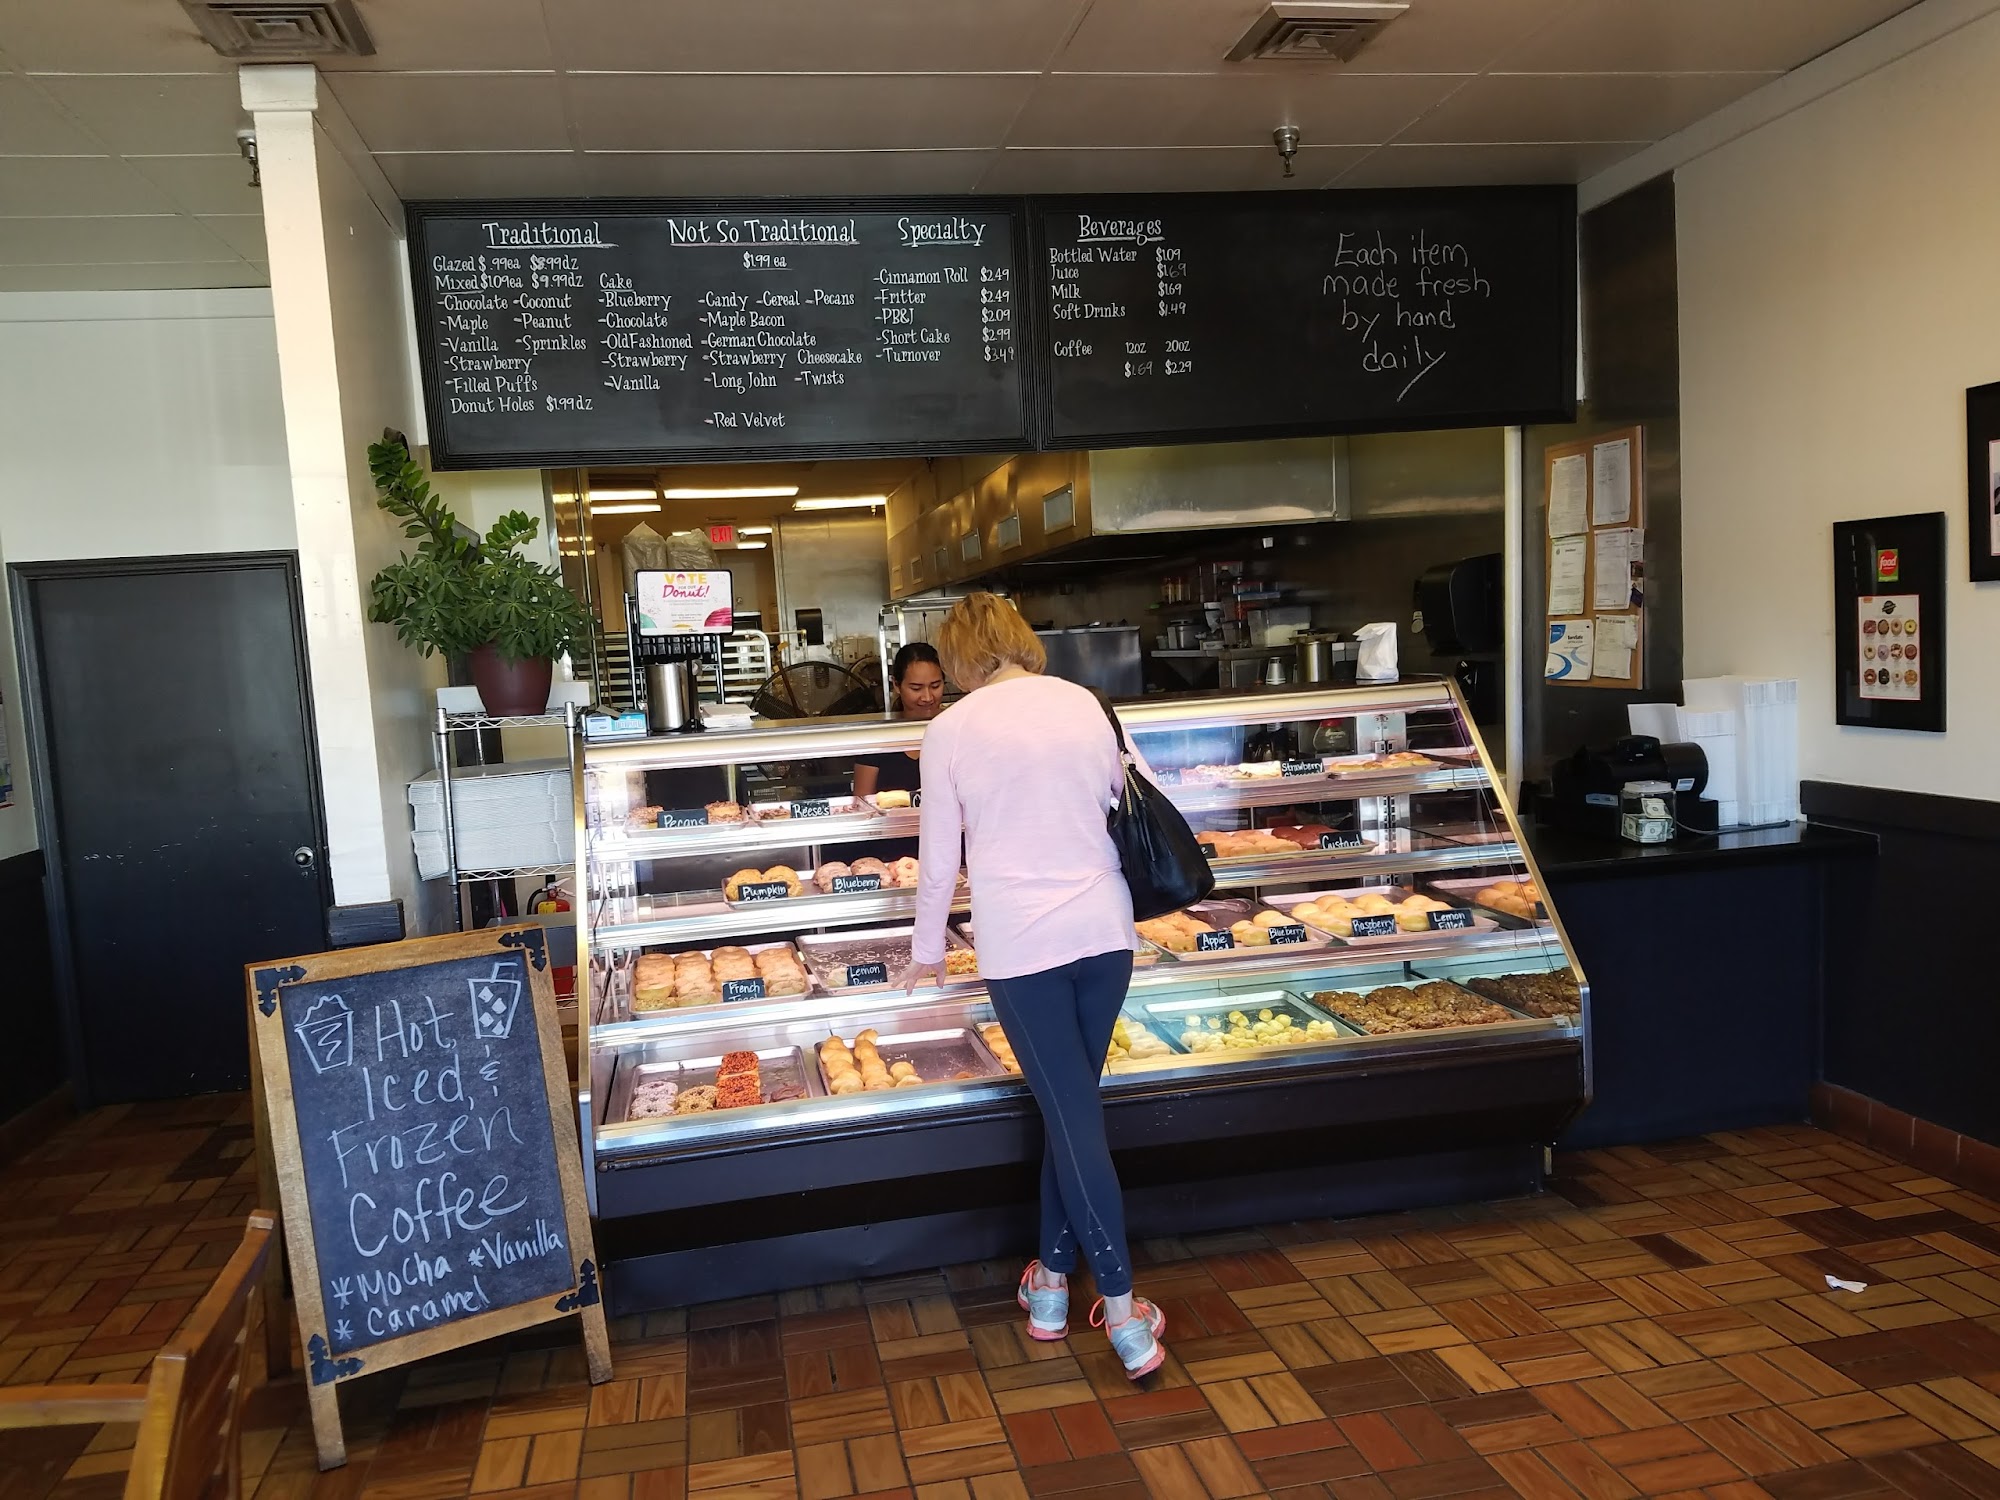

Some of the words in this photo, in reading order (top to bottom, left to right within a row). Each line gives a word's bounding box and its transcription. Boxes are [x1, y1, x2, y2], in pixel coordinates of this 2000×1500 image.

[482, 222, 602, 245] Traditional
[667, 219, 710, 244] Not
[716, 220, 739, 243] So
[744, 219, 857, 243] Traditional
[898, 217, 986, 247] Specialty
[1078, 214, 1162, 246] Beverages
[1050, 247, 1094, 264] Bottled
[1096, 247, 1137, 263] Water
[1335, 230, 1397, 267] Each
[1411, 229, 1468, 267] item
[433, 256, 476, 272] Glazed
[1051, 264, 1080, 280] Juice
[435, 275, 480, 290] Mixed
[600, 273, 633, 289] Cake
[944, 266, 968, 283] Roll
[980, 266, 1010, 283] $2.49
[1323, 270, 1399, 298] made
[1416, 266, 1490, 297] fresh
[980, 287, 1010, 304] $2.49
[1051, 284, 1082, 299] Milk
[981, 306, 1011, 324] $2.09
[1053, 303, 1081, 320] Soft
[1084, 302, 1126, 318] Drinks
[1158, 300, 1187, 317] $1.49
[750, 311, 785, 327] Bacon
[1341, 299, 1380, 343] by
[1397, 299, 1456, 329] hand
[758, 331, 817, 349] Chocolate
[921, 327, 950, 343] Cake
[982, 325, 1011, 343] $2.99
[797, 348, 863, 364] Cheesecake
[1054, 339, 1093, 357] Coffee
[1165, 359, 1192, 376] $2.29
[1362, 335, 1446, 402] daily
[496, 375, 538, 393] Puffs
[748, 371, 777, 389] John
[451, 398, 495, 414] Donut
[498, 397, 535, 412] Holes
[741, 410, 785, 428] Velvet
[711, 526, 733, 542] EXIT
[1879, 555, 1897, 570] food
[664, 574, 707, 584] VOTE
[663, 585, 710, 598] Donut!
[1281, 761, 1323, 772] Strawberry
[792, 802, 830, 818] Reese's
[1322, 834, 1363, 850] Custard
[742, 884, 787, 898] Pumpkin
[834, 878, 880, 890] Blueberry
[1352, 918, 1394, 932] Raspberry
[1433, 911, 1466, 922] Lemon
[1202, 934, 1228, 947] Apple
[1269, 927, 1305, 939] Blueberry
[850, 965, 881, 976] Lemon
[728, 981, 761, 995] French
[376, 996, 457, 1062] Hot,
[363, 1054, 474, 1120] Iced,
[327, 1106, 525, 1188] Frozen
[349, 1172, 528, 1257] Coffee
